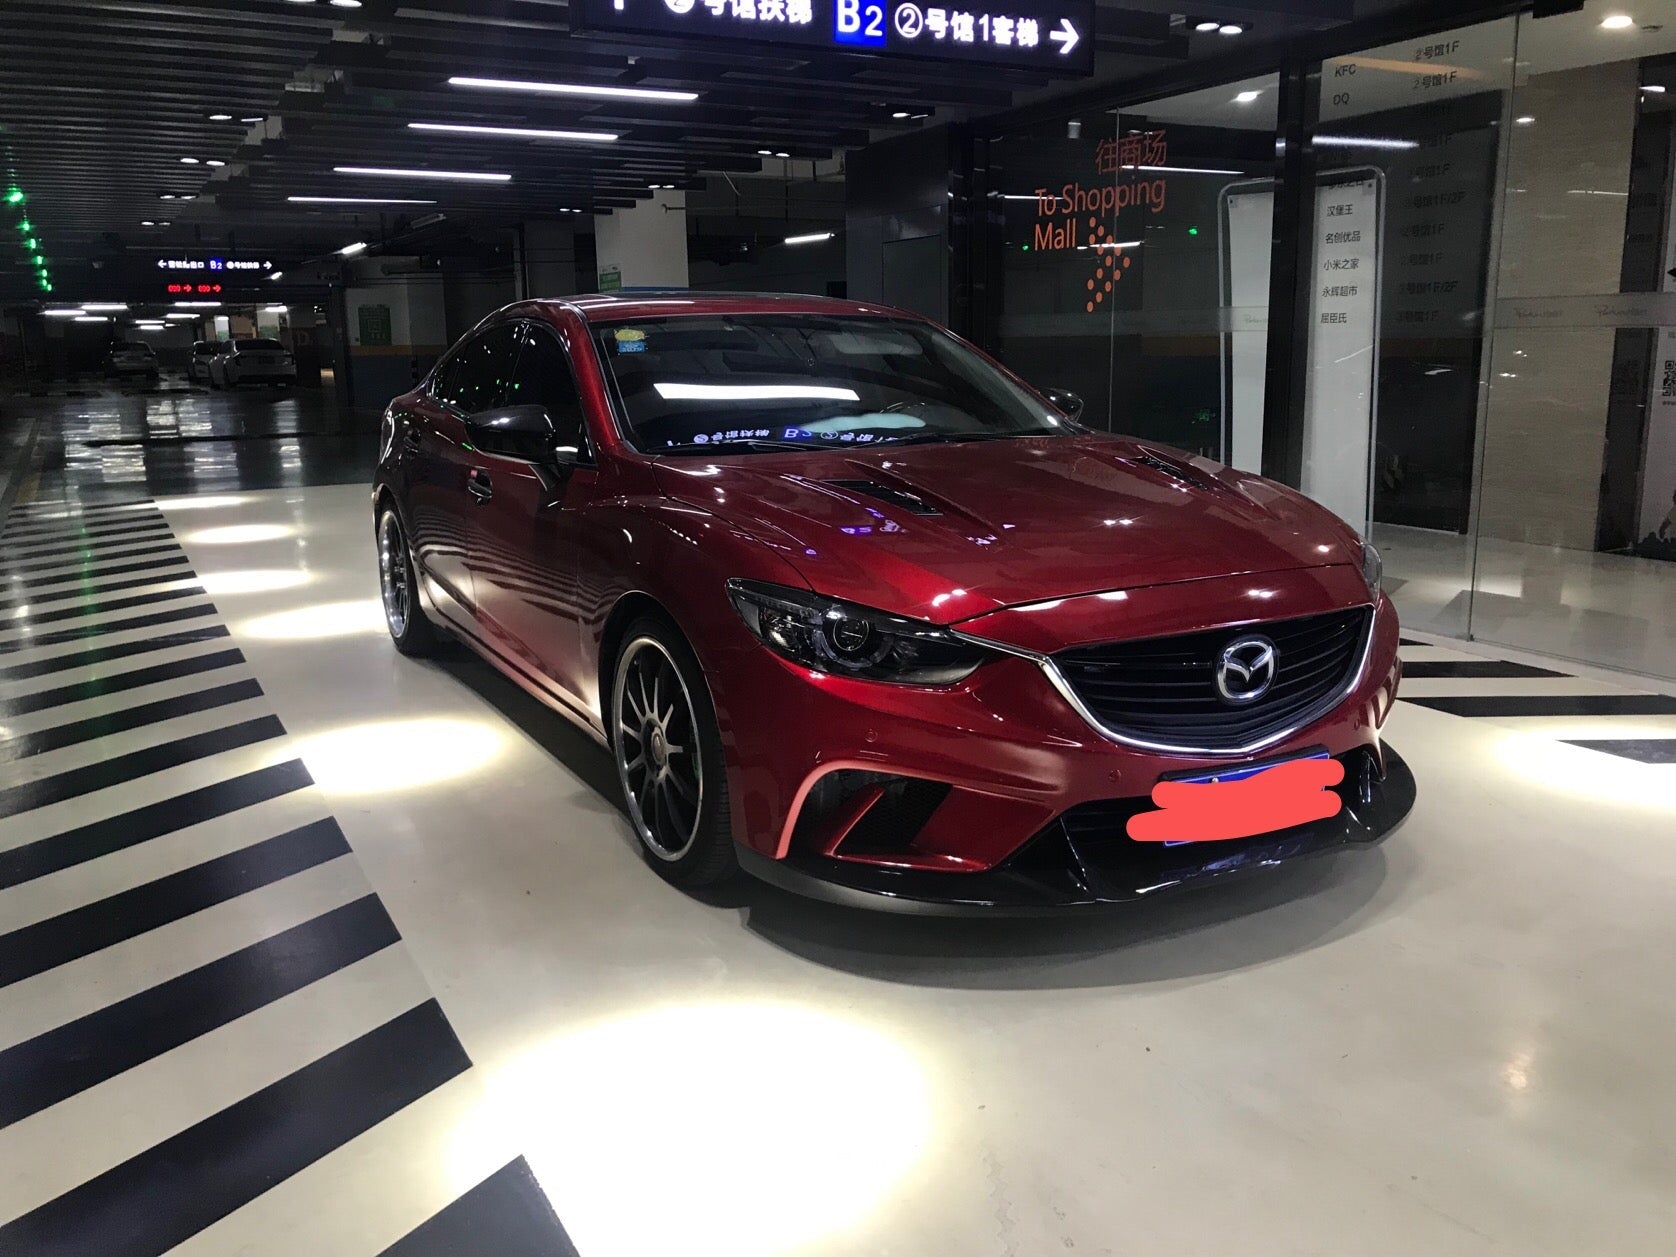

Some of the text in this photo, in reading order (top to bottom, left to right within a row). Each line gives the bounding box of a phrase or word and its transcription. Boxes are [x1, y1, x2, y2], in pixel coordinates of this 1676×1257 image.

[837, 0, 883, 36] B2
[1334, 63, 1356, 78] KFC
[1096, 129, 1167, 175] 往商场
[1035, 175, 1166, 218] To Shopping
[1327, 204, 1353, 217] 汉堡王
[1035, 218, 1076, 251] Mall
[1325, 230, 1361, 244] 名创优品
[1323, 258, 1360, 271] 小米之家
[1322, 285, 1358, 298] 永辉超市
[1320, 312, 1348, 324] 屈臣氏
